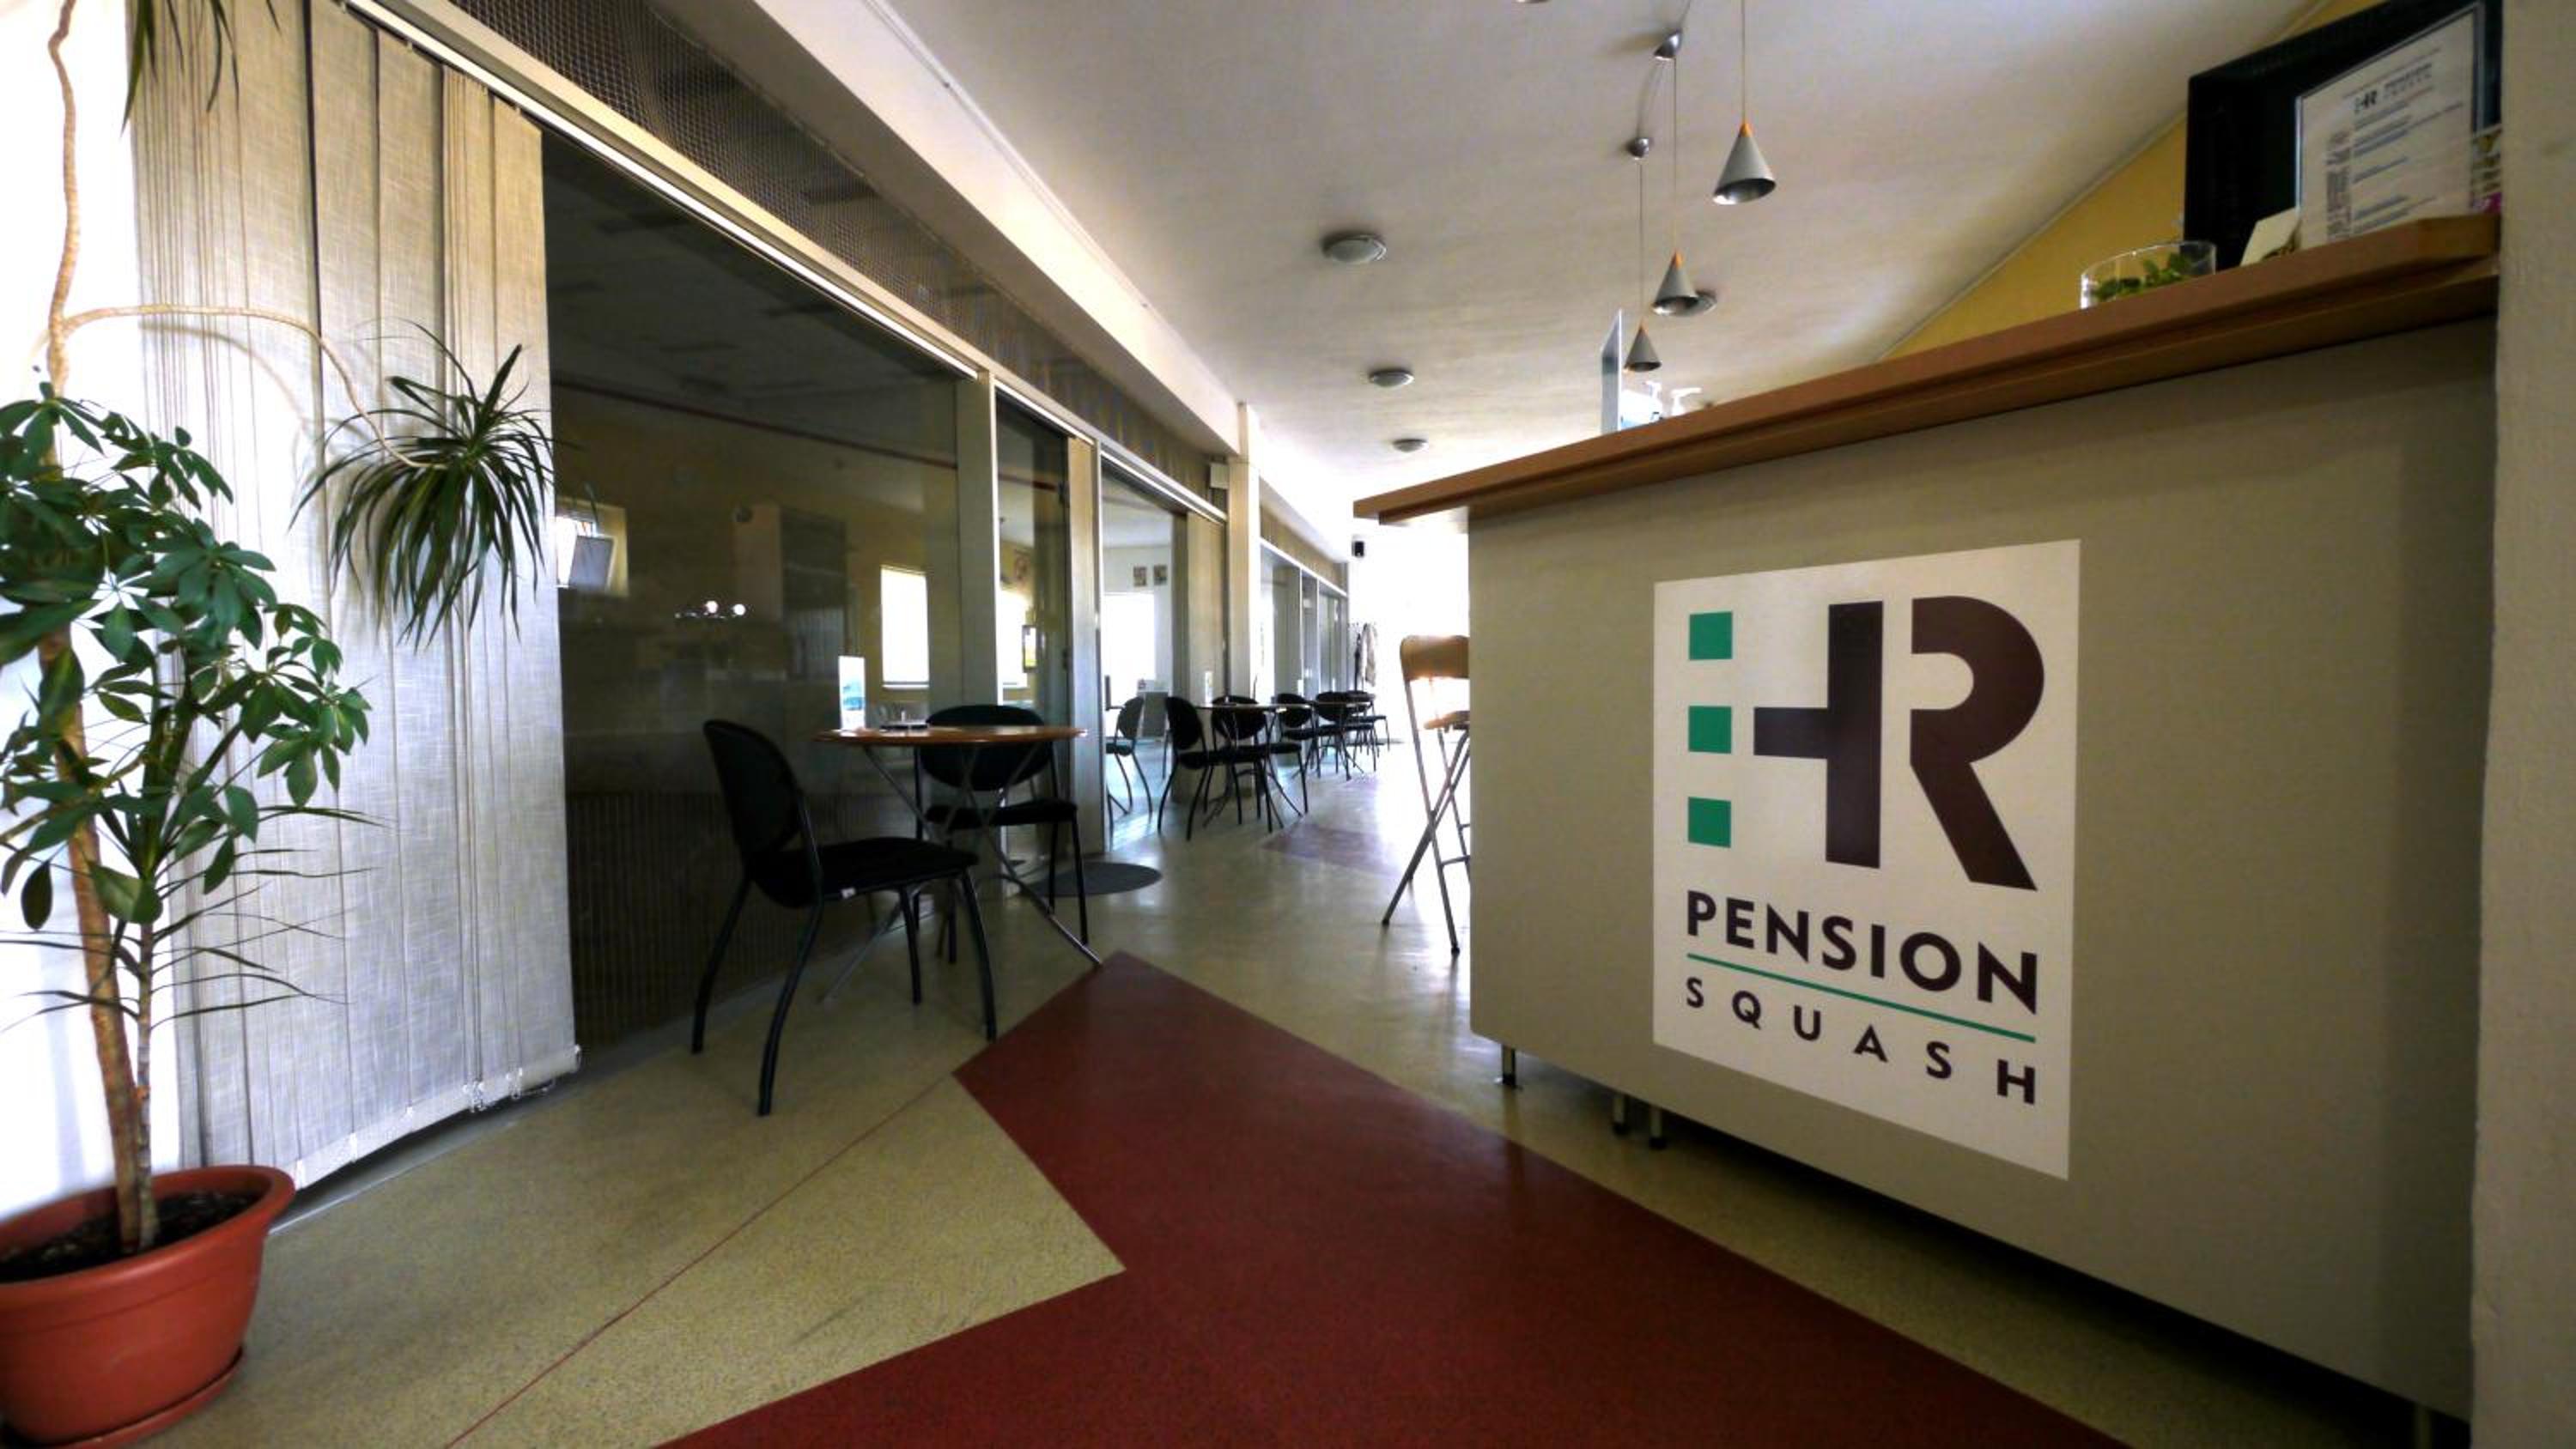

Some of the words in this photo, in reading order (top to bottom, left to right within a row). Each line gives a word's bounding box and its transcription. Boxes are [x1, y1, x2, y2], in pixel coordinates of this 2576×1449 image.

[1687, 595, 2044, 891] HR
[1687, 889, 2038, 1015] PENSION
[1687, 977, 2036, 1105] SQUASH
